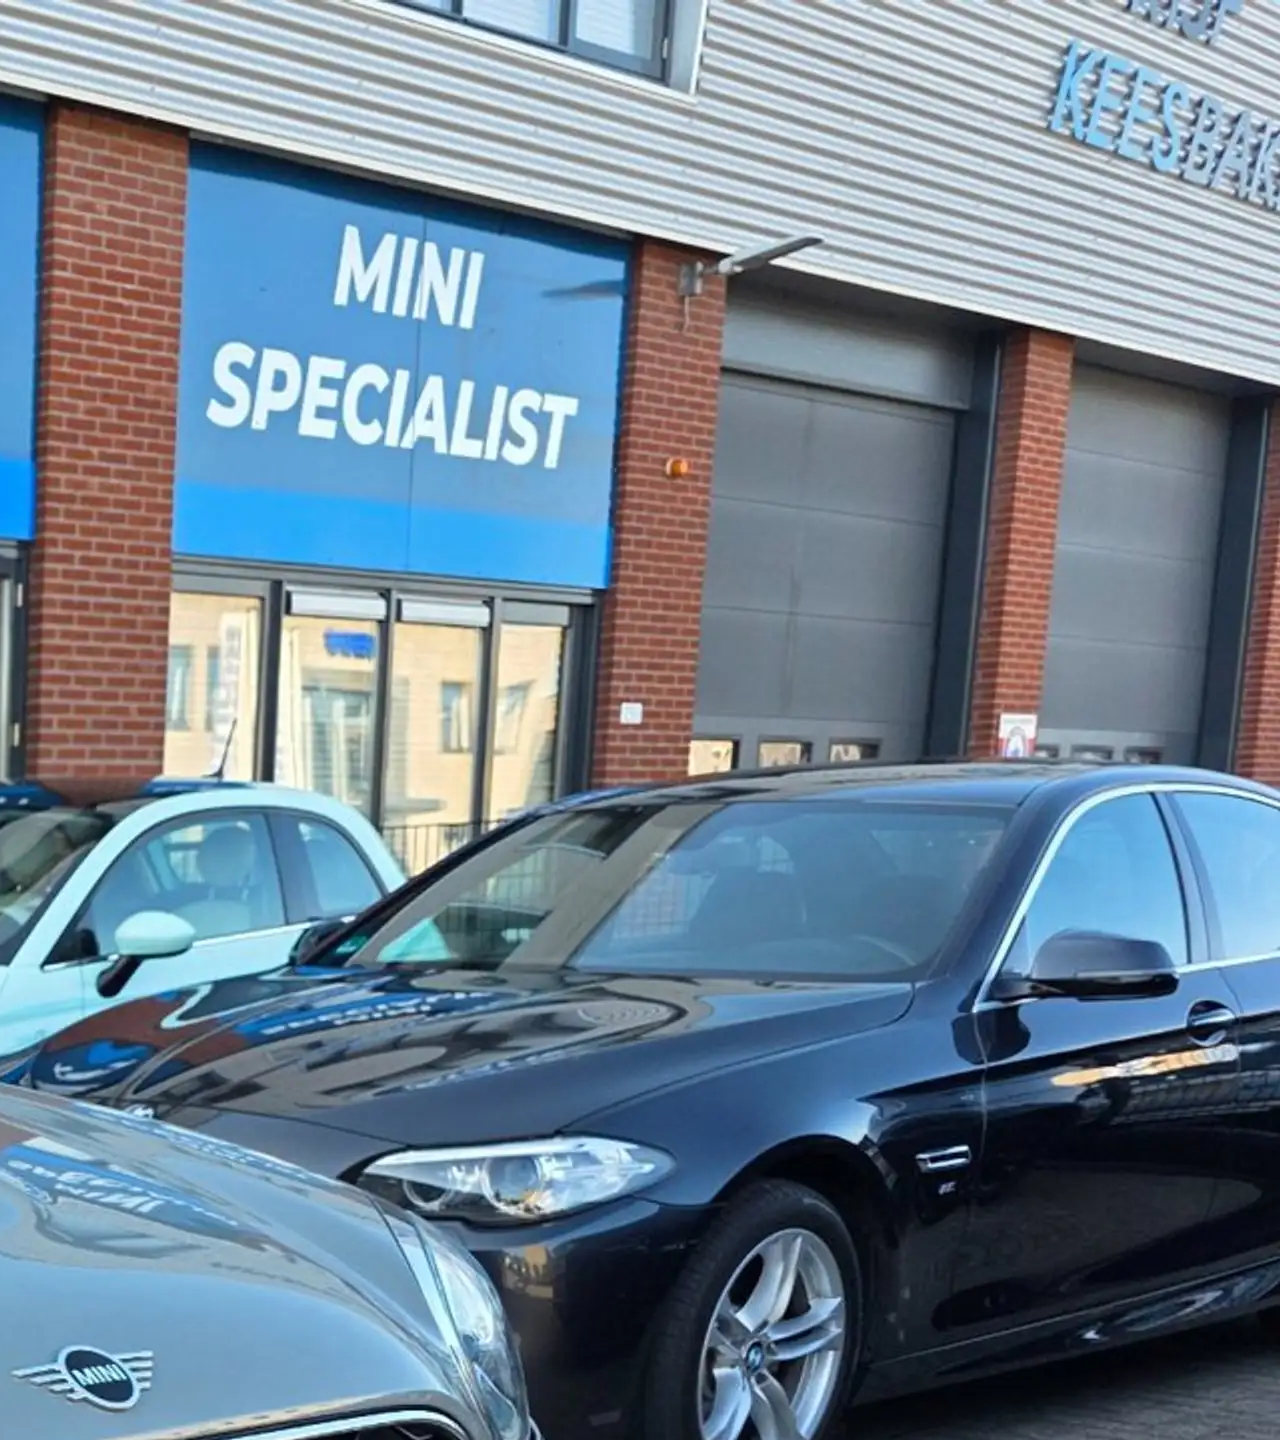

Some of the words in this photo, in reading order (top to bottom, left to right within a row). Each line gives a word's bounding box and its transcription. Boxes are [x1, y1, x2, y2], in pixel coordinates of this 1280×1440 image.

[334, 224, 484, 329] MINI
[206, 342, 578, 469] SPECIALIST
[70, 1363, 128, 1387] MINI
